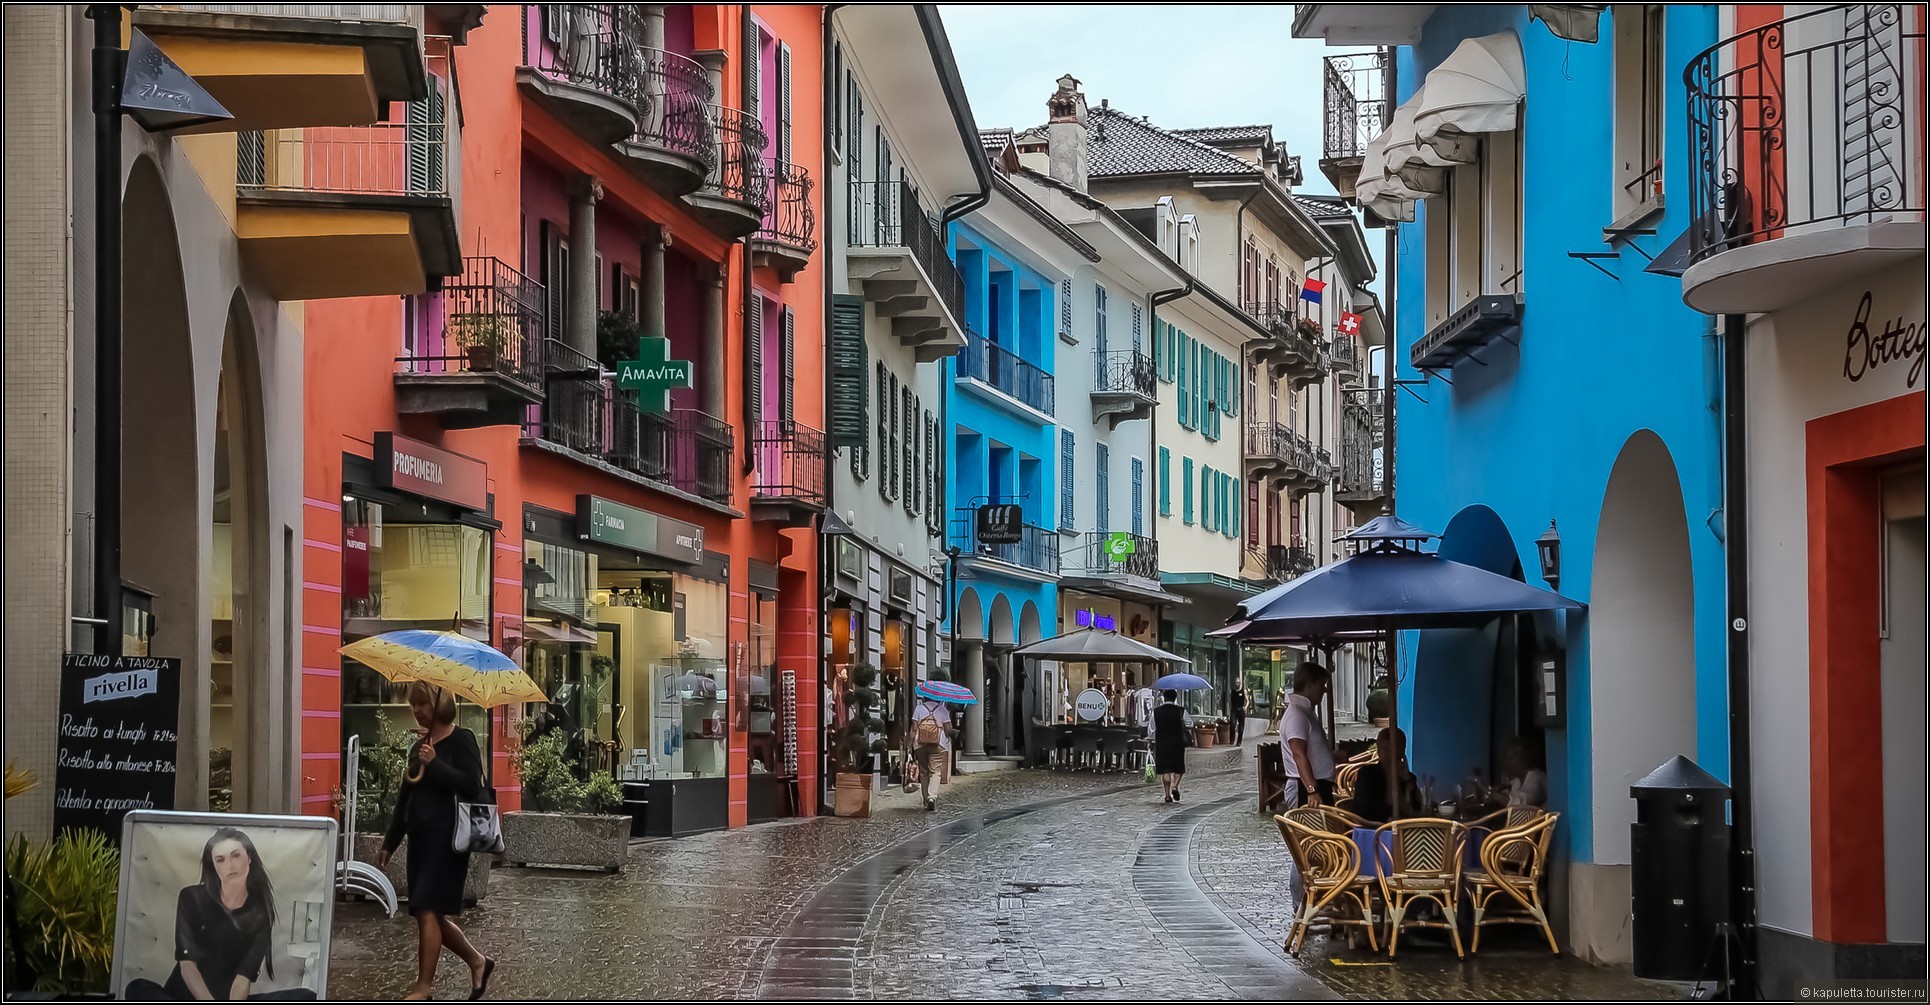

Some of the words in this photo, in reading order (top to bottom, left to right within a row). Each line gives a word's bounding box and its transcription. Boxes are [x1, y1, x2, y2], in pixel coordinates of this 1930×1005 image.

[394, 450, 443, 485] PROFUMERIA
[605, 515, 625, 531] FARMACIA
[65, 655, 110, 668] TICINO
[114, 657, 124, 668] A
[127, 658, 170, 670] TAVOLA
[93, 673, 149, 697] rivella
[1077, 702, 1098, 710] BENU
[61, 713, 99, 738] Risotto
[103, 728, 114, 739] ai
[58, 748, 95, 769] Risotto
[96, 754, 113, 770] alla
